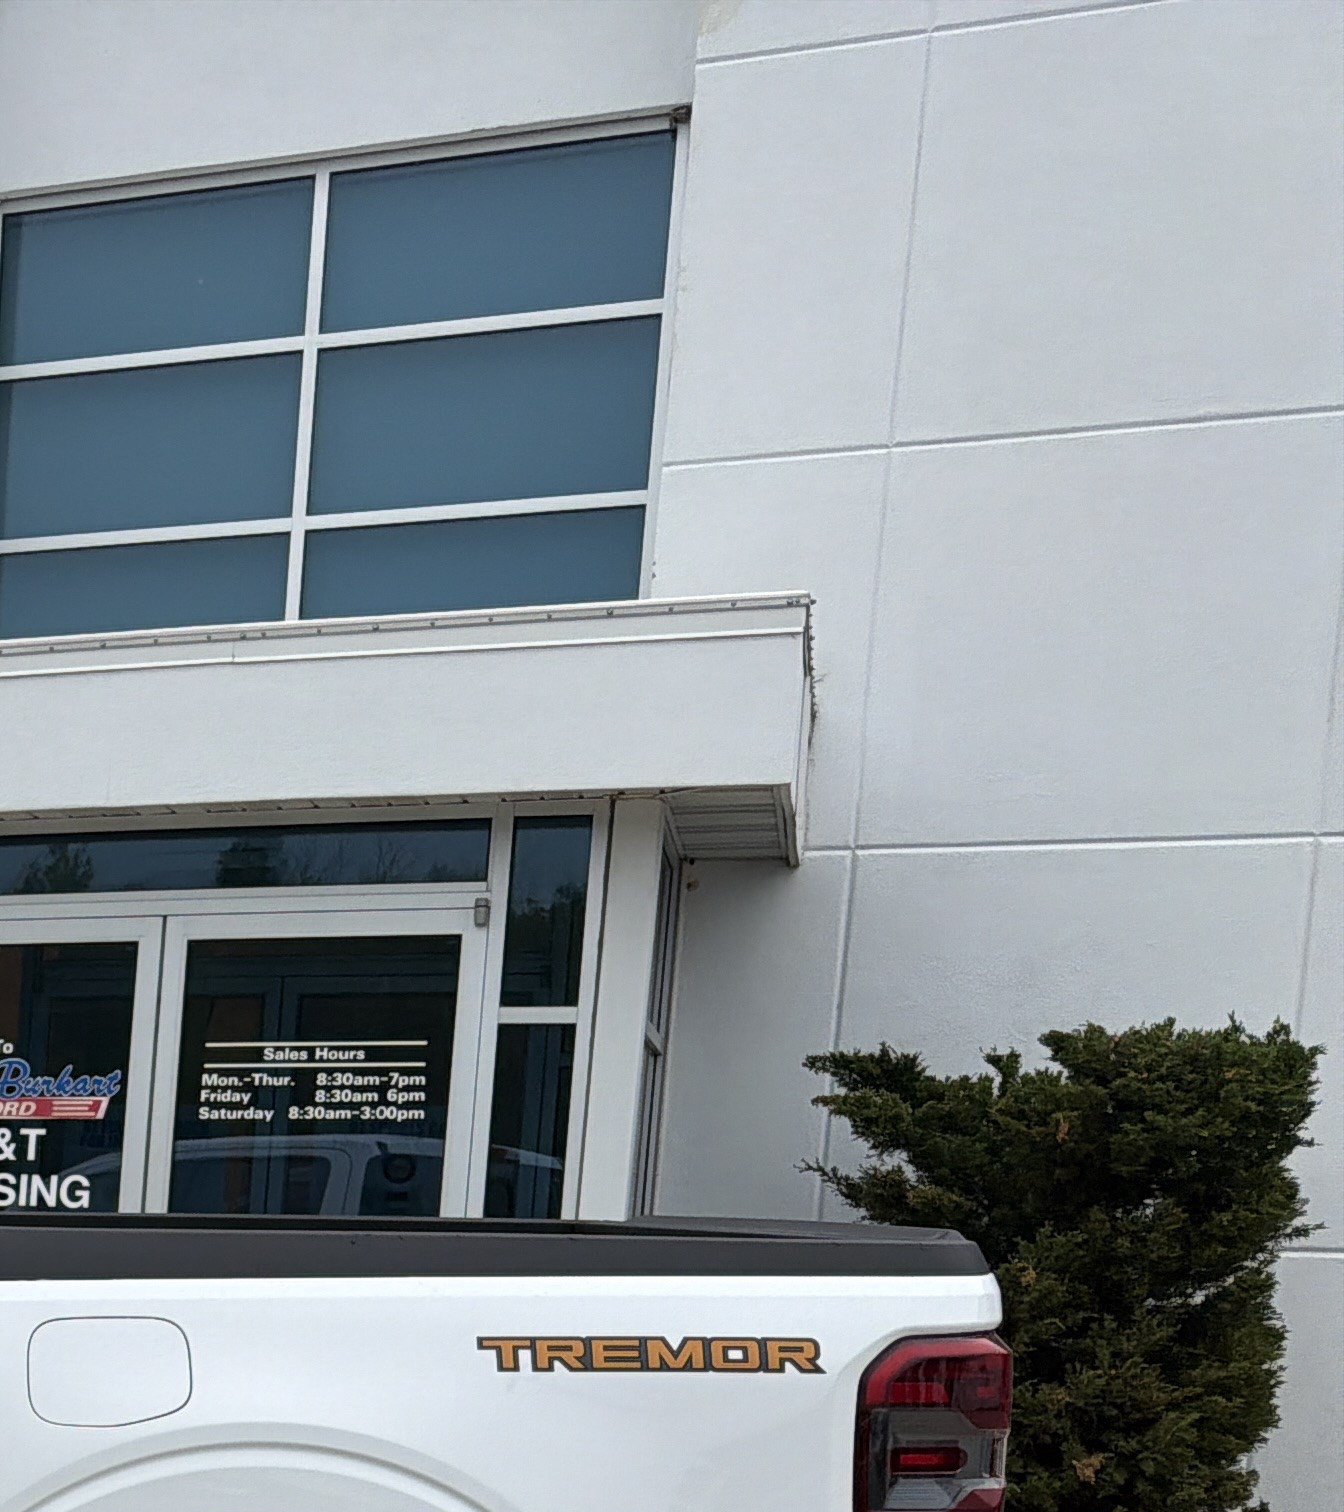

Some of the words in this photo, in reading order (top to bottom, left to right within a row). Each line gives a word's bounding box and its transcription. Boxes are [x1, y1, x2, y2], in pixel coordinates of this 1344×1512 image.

[262, 1047, 308, 1061] Sales
[314, 1047, 366, 1061] Hours
[201, 1072, 296, 1087] Mon.-Thur.
[315, 1071, 426, 1089] 8:30am-7pm
[200, 1089, 252, 1105] Friday
[314, 1088, 379, 1103] 8:30am
[386, 1088, 426, 1104] 6pm
[198, 1106, 275, 1122] Saturday
[288, 1105, 425, 1123] 8:30am-3:00pm
[476, 1336, 827, 1374] TREMOR
